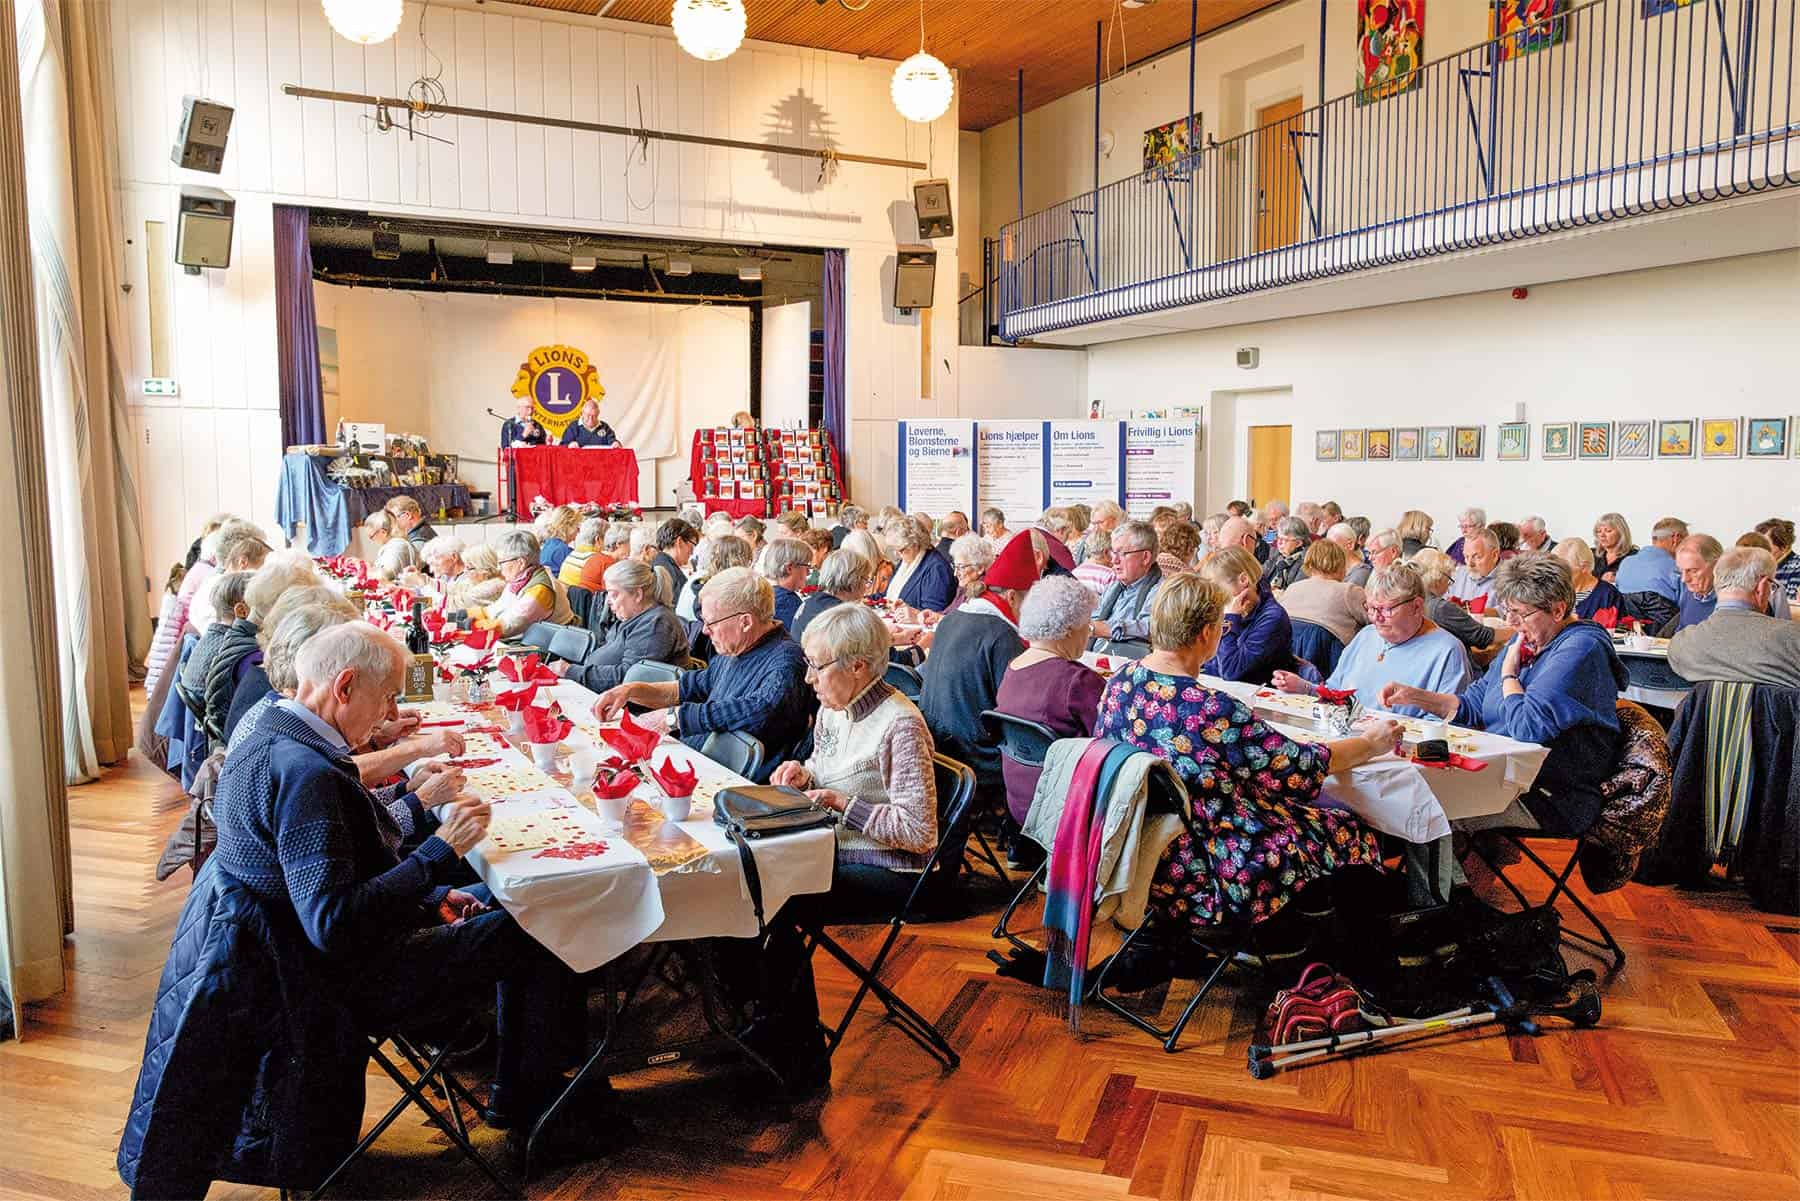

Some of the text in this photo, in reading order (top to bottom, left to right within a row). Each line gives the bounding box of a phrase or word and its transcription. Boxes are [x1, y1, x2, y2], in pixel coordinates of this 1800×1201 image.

[534, 350, 583, 368] LIONS
[547, 372, 572, 405] L
[909, 427, 946, 436] Løverne,
[980, 431, 1040, 442] Lions hjælper
[1053, 431, 1096, 440] Om Lions
[1128, 427, 1161, 438] Frivillig
[1168, 427, 1193, 436] Lions
[909, 437, 959, 446] Blomsterne
[909, 447, 951, 457] og Bierne
